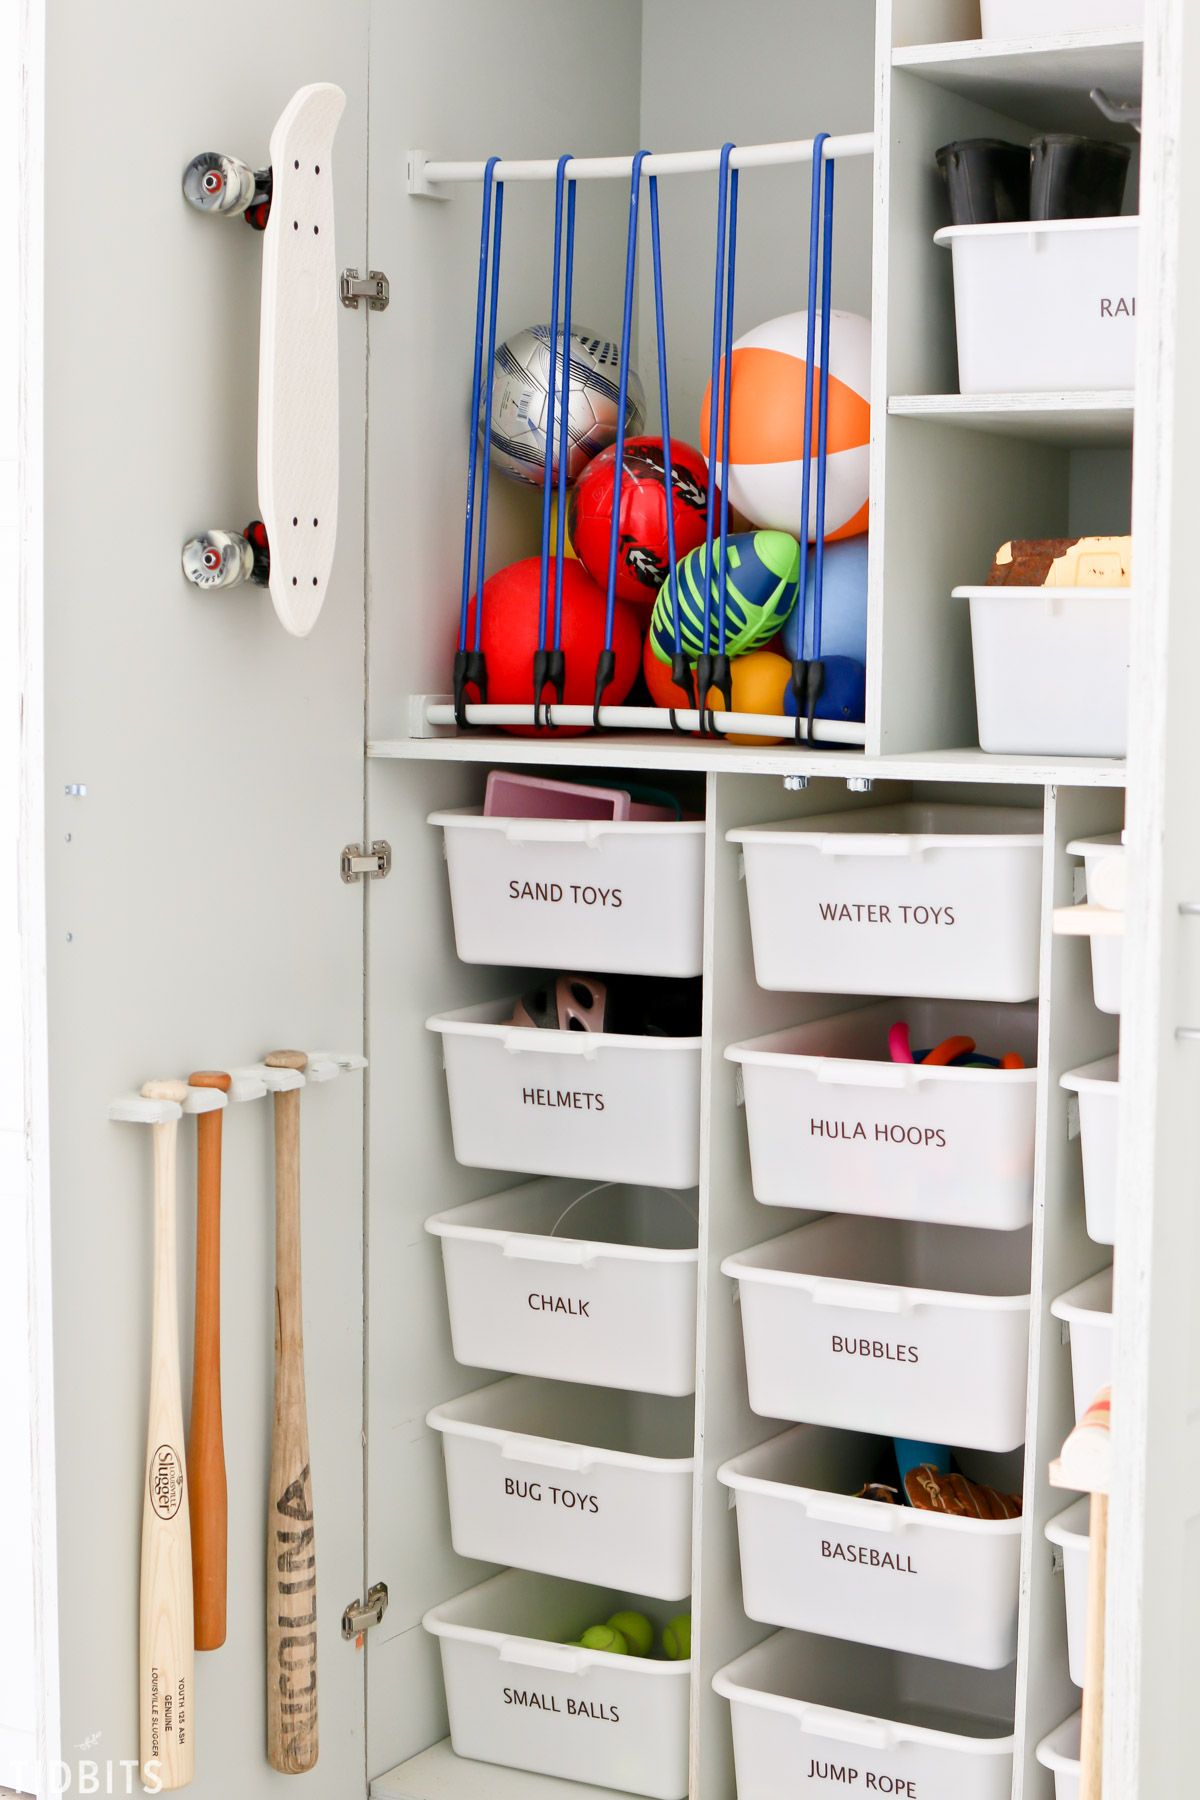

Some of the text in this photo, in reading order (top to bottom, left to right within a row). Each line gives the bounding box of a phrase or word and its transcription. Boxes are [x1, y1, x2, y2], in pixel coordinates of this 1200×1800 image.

[509, 880, 623, 908] SAND TOYS
[818, 902, 955, 926] WATER TOYS
[522, 1087, 605, 1112] HELMETS
[810, 1117, 947, 1148] HULA HOOPS
[527, 1293, 590, 1318] CHALK
[831, 1335, 920, 1364] BUBBLES
[155, 1453, 173, 1512] Slugger
[504, 1477, 599, 1514] BUG TOYS
[821, 1539, 918, 1574] BASEBALL
[164, 1694, 173, 1732] GENUINE
[503, 1687, 620, 1723] SMALL BALLS
[807, 1759, 917, 1800] JUMP ROPE
